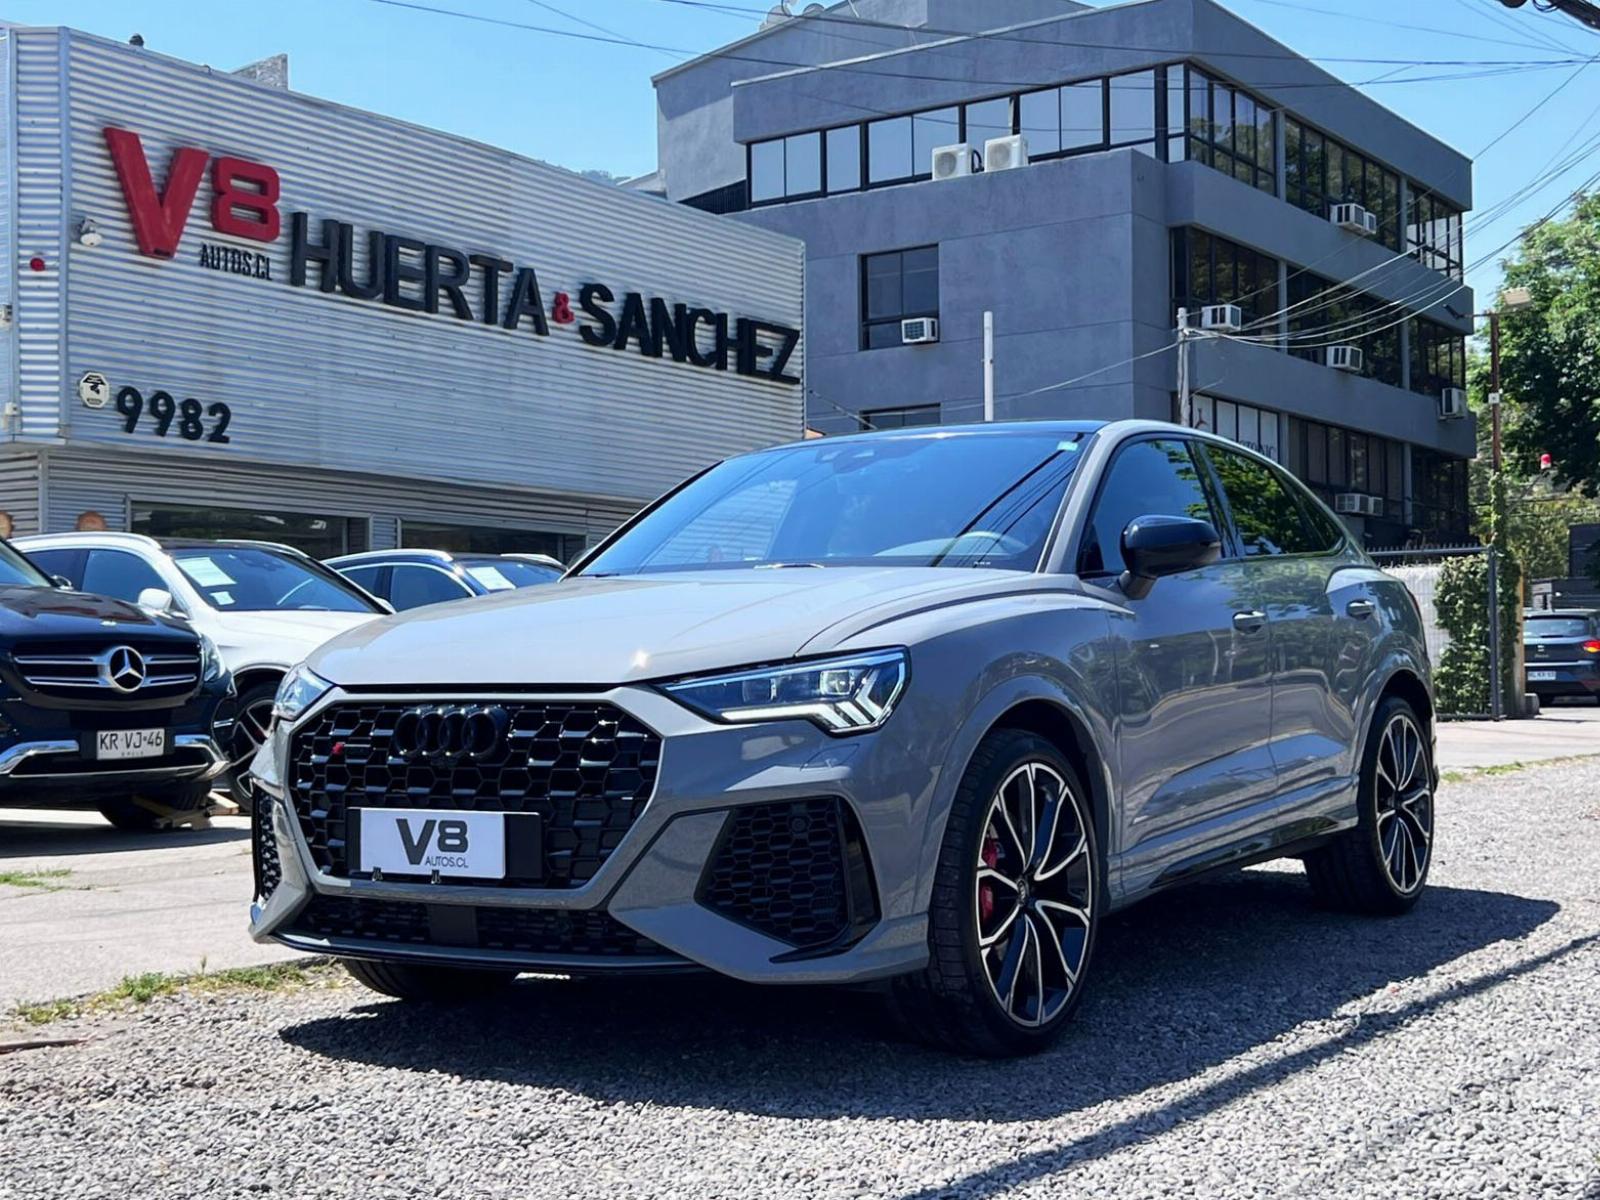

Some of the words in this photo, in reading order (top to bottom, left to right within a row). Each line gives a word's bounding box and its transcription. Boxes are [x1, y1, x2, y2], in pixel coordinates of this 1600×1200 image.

[103, 127, 280, 260] V8
[200, 244, 272, 281] AUTOS.CL
[291, 212, 549, 336] HUERTA
[552, 291, 574, 324] &
[579, 282, 800, 384] SANCHEZ
[116, 386, 231, 444] 9982
[395, 818, 468, 865] V8
[425, 856, 469, 868] AUTOS.CL
